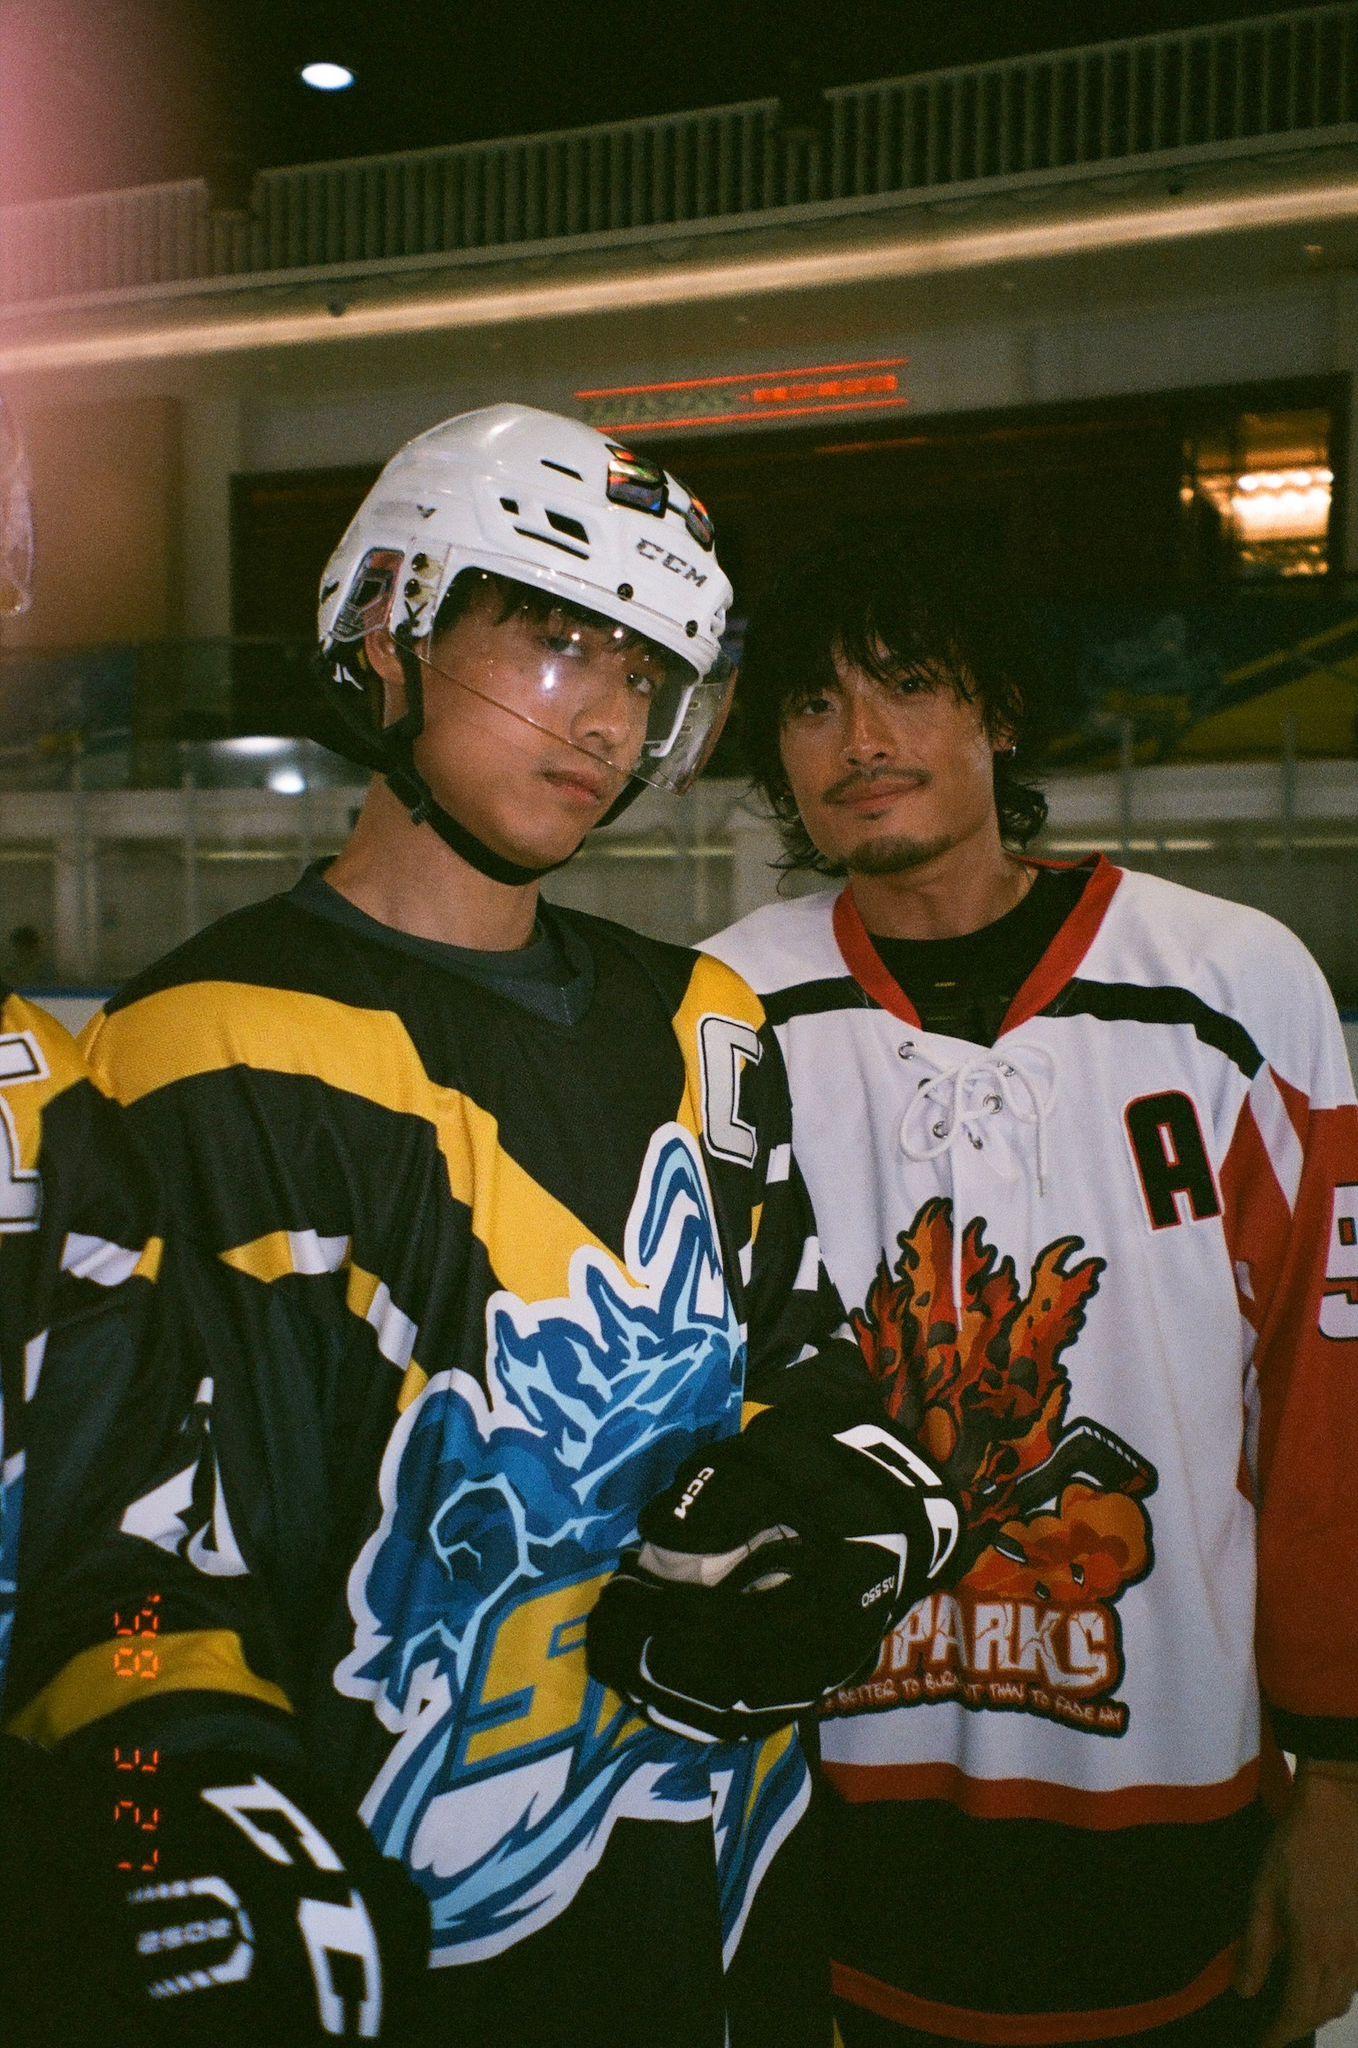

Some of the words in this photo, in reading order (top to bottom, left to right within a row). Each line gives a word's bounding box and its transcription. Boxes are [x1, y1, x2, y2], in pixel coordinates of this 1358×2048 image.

[636, 537, 708, 588] CCM
[697, 1012, 763, 1169] C
[1122, 1088, 1223, 1232] A
[673, 1466, 715, 1519] CCM
[874, 1592, 1109, 1689] PARKS
[901, 1678, 920, 1696] TO
